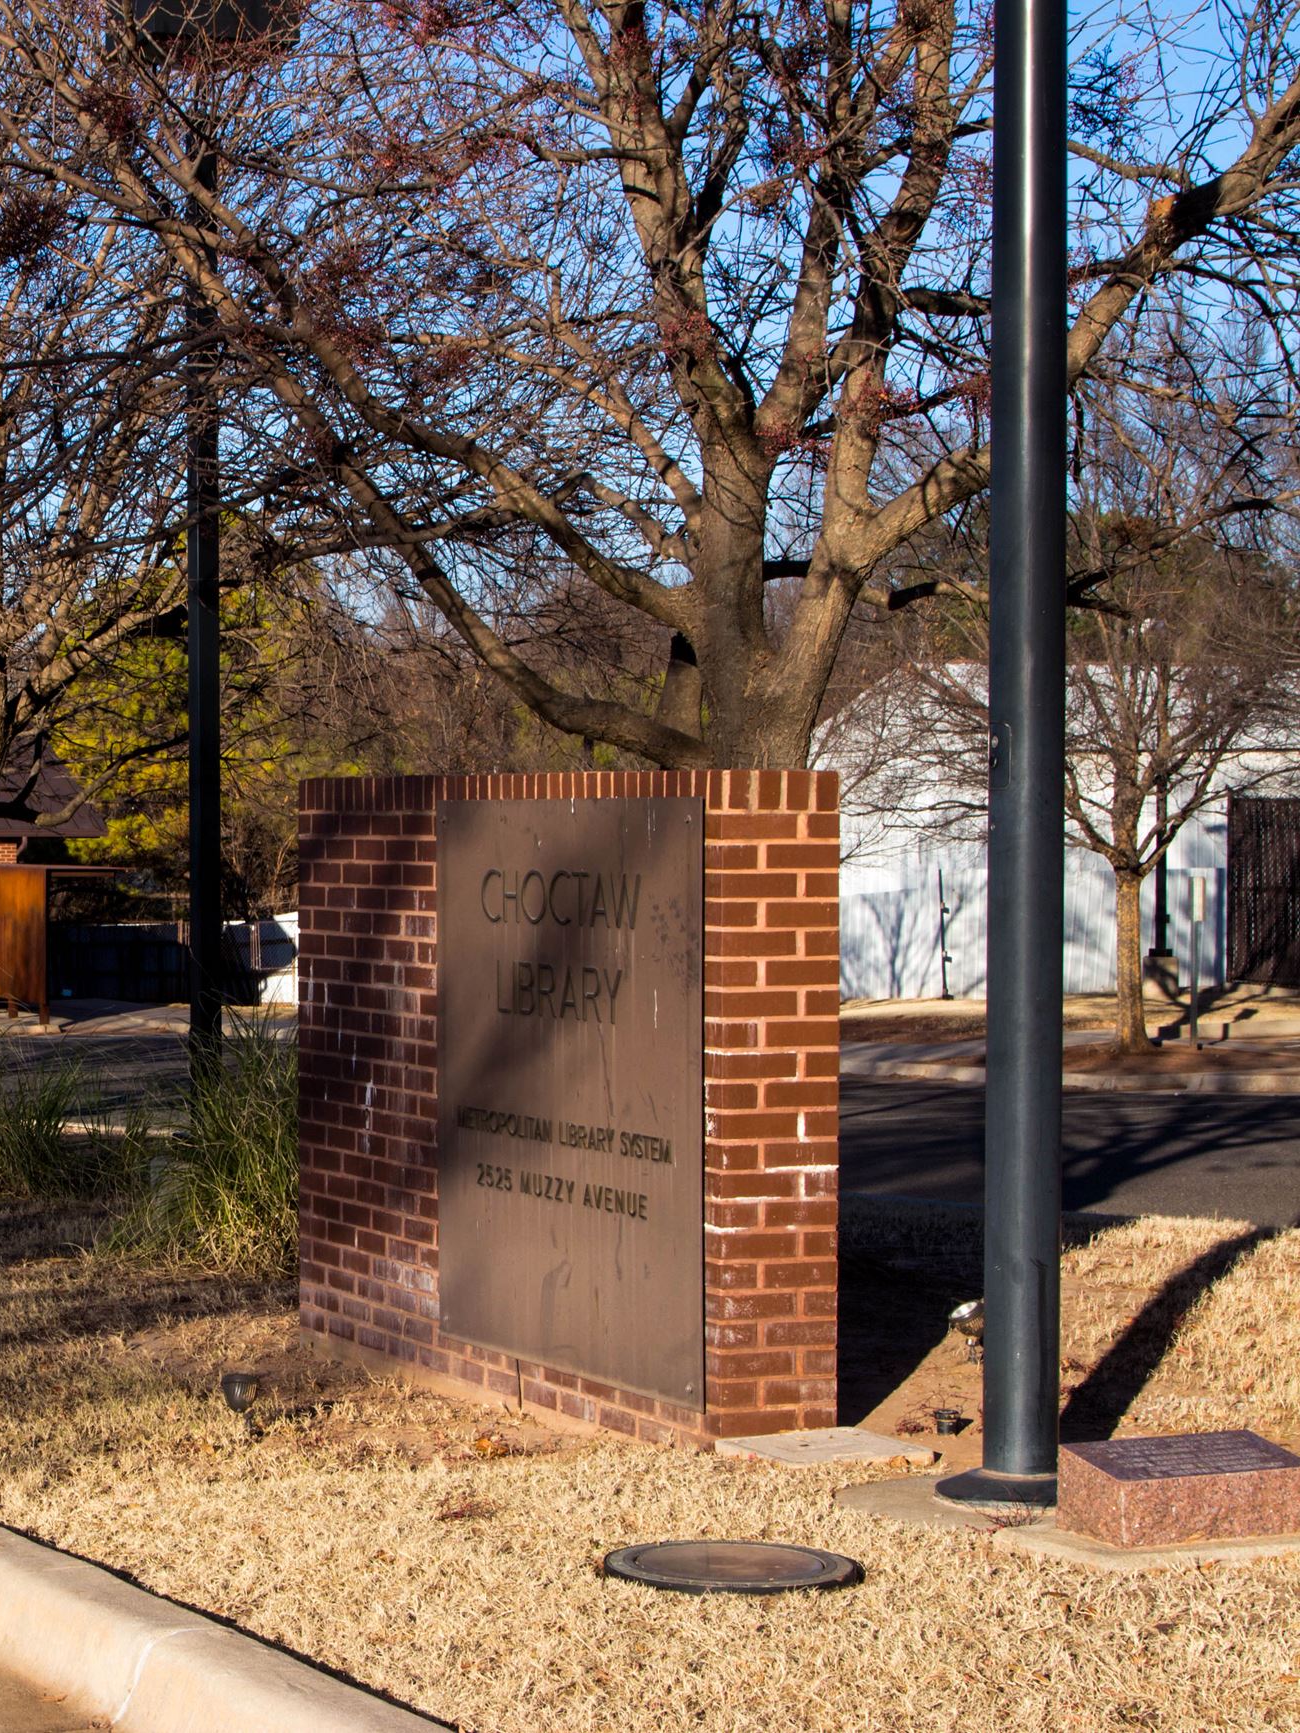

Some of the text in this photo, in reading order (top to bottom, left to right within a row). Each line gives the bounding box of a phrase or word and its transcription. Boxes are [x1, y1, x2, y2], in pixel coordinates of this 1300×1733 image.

[481, 869, 642, 930] CHOCTAW
[496, 960, 623, 1025] LIBRARY
[457, 1105, 673, 1165] METROPOLITAN LIBRARY SYSTEM
[476, 1162, 649, 1221] 2525 MUZZY AVENUE
